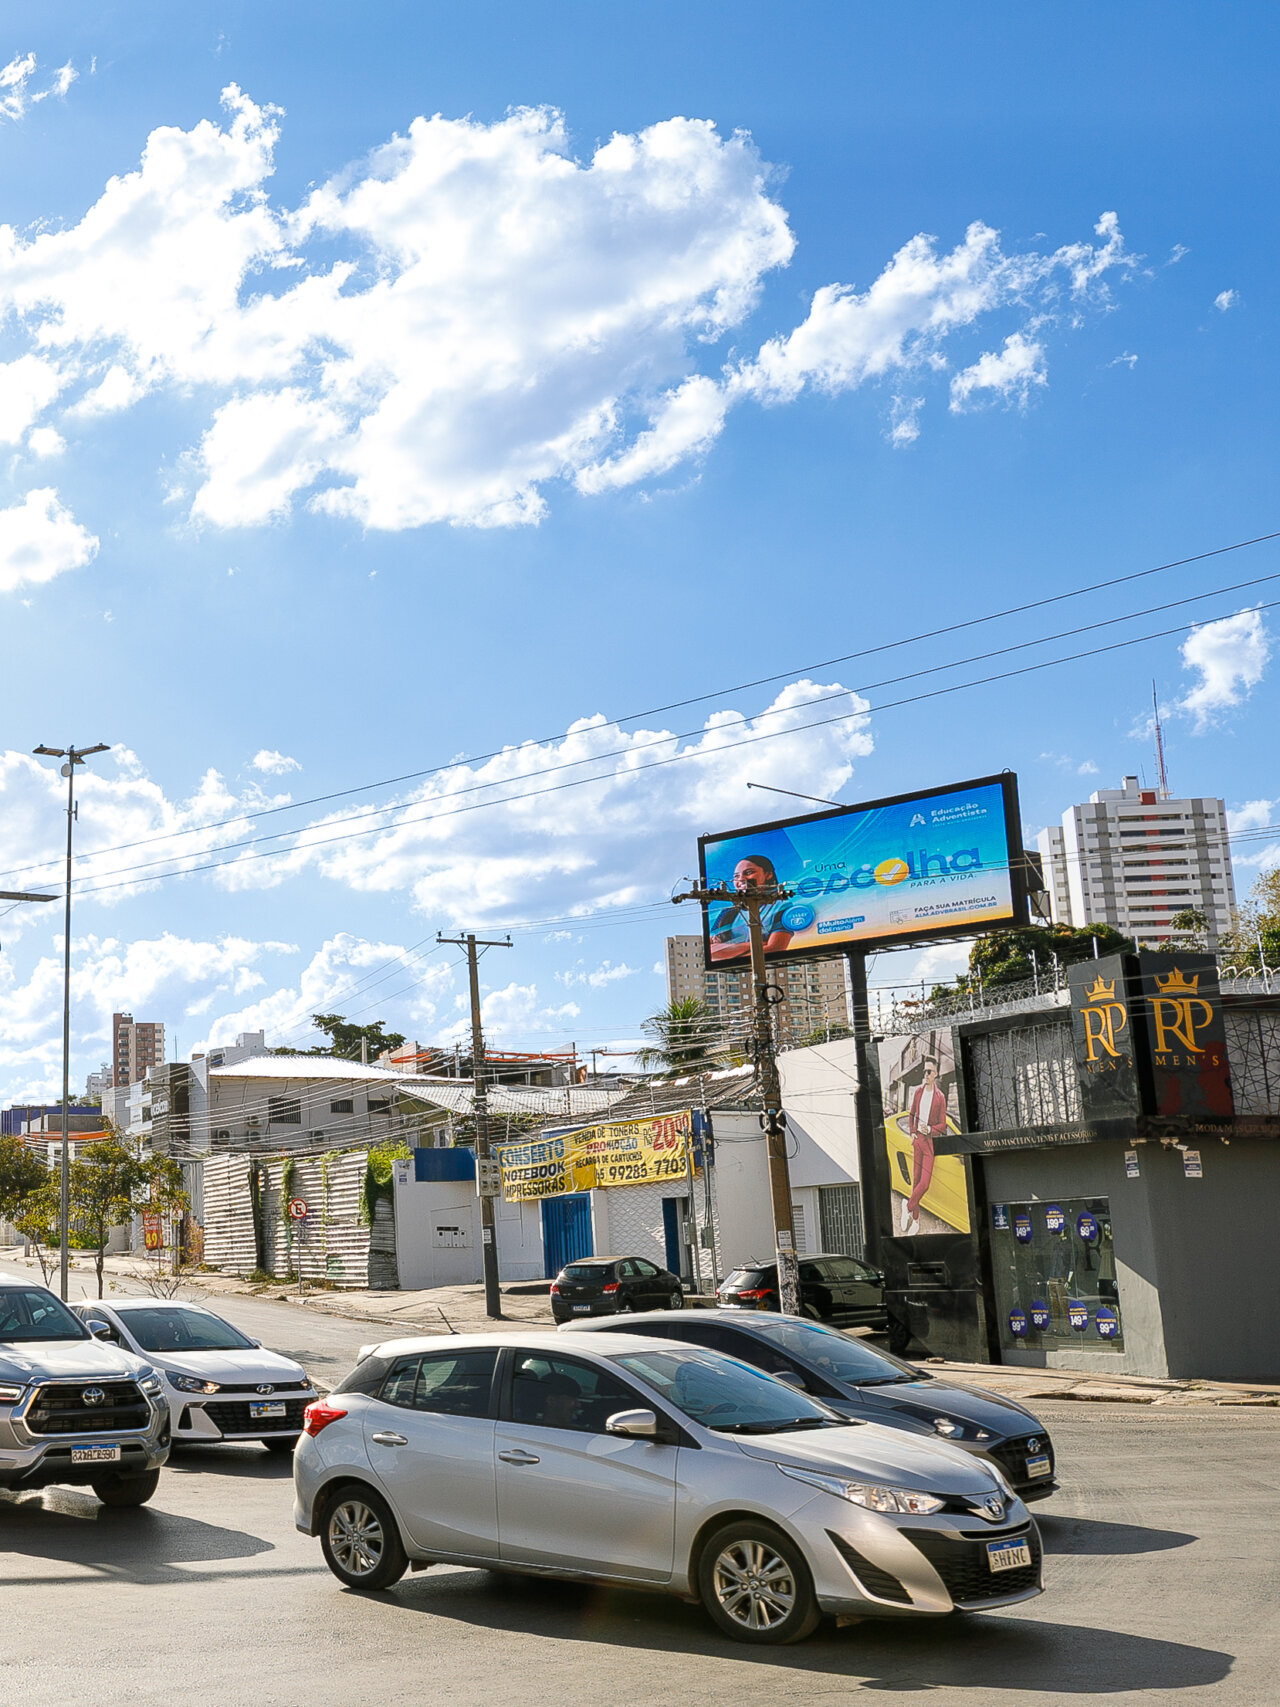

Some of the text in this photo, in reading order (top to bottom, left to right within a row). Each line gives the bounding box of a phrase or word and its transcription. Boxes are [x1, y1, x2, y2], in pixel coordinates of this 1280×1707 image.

[932, 809, 987, 823] Adventista
[910, 879, 936, 889] PARA
[914, 904, 935, 914] FAÇA
[935, 901, 952, 910] SUA
[1080, 1002, 1127, 1062] RP
[1147, 998, 1213, 1053] RP
[1154, 1055, 1220, 1066] MEN'S
[609, 1123, 640, 1138] TONERS
[499, 1138, 564, 1168] CONSERTO
[503, 1160, 566, 1182] NOTEBOOK
[504, 1175, 566, 1199] IMPRESSORAS
